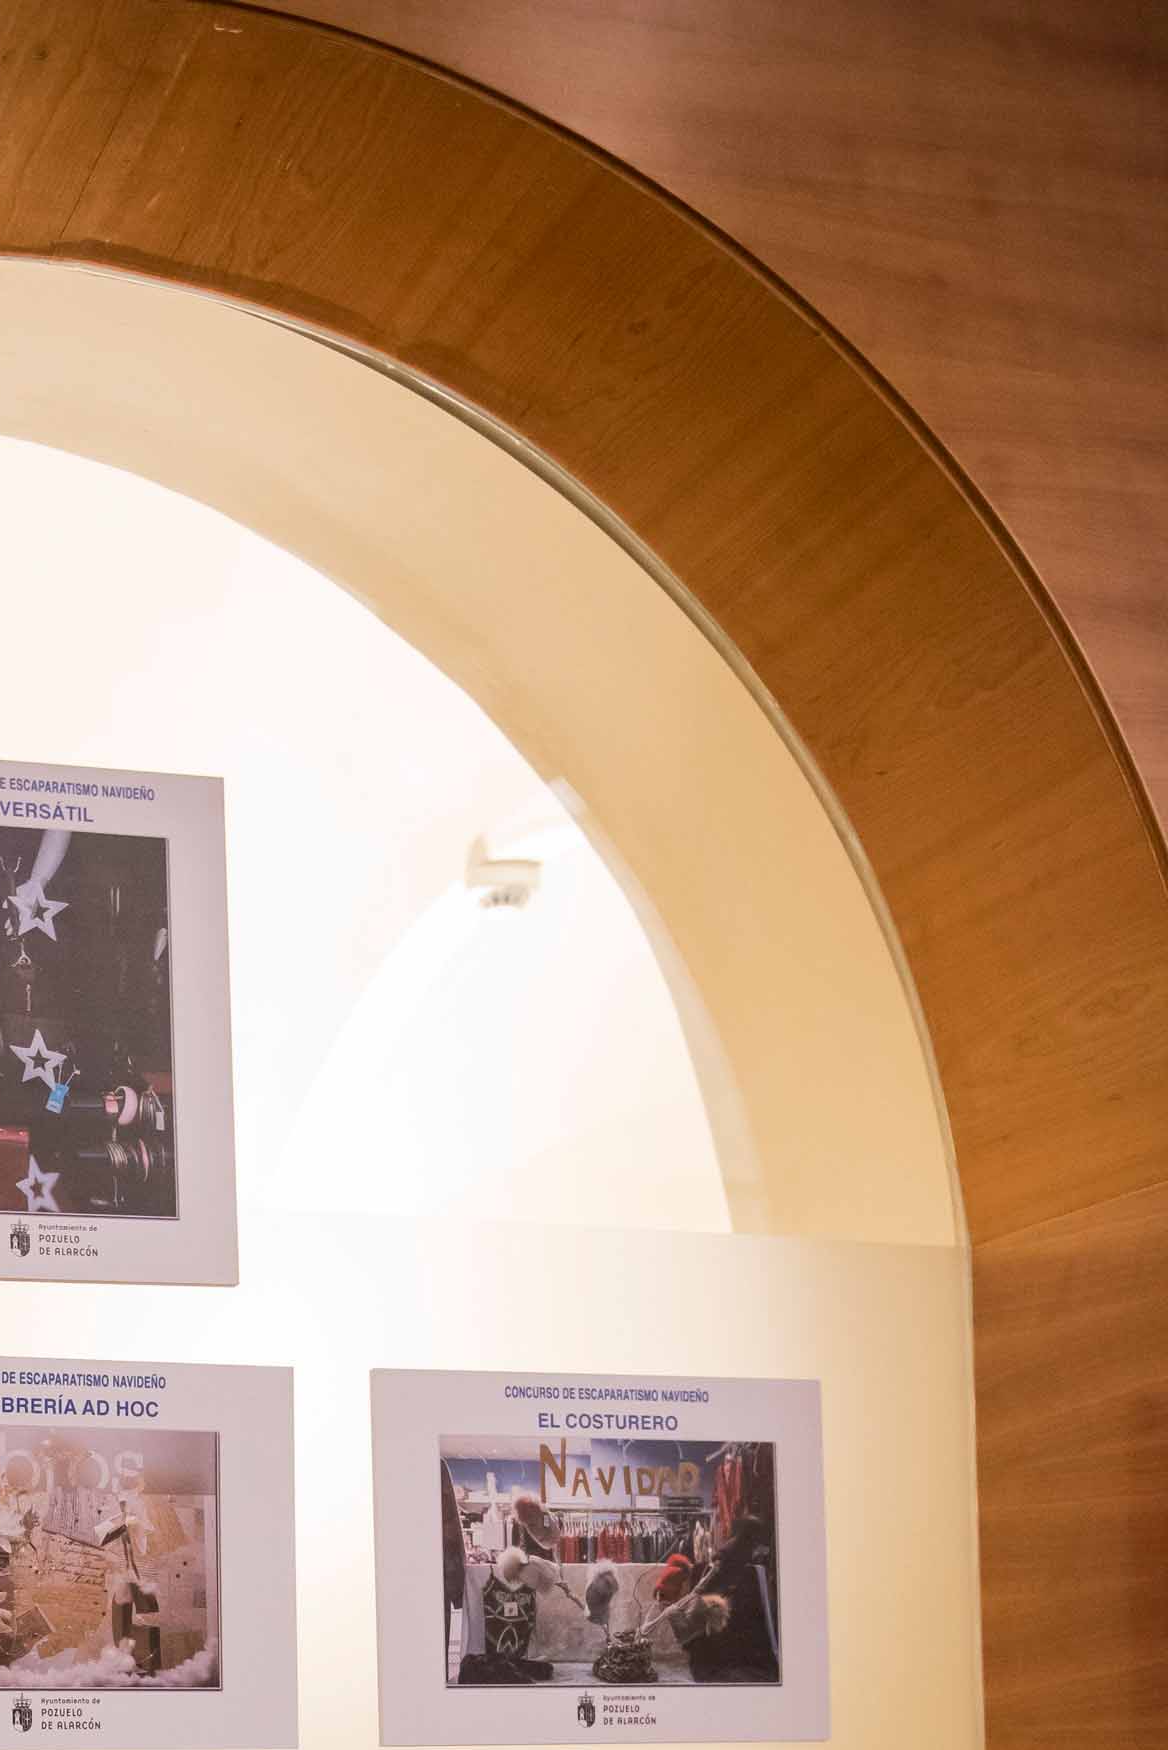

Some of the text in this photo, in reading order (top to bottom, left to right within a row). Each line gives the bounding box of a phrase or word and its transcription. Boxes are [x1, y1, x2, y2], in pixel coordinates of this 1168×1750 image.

[8, 777, 98, 796] ESCAPARATISMO
[101, 785, 154, 800] NAVIDEÑO
[0, 800, 93, 822] VERSÁTIL
[38, 1223, 87, 1232] Ayuntamiento
[38, 1233, 80, 1244] POZUELO
[39, 1244, 98, 1256] DE ALARCÓN
[1, 1371, 16, 1384] DE
[19, 1371, 109, 1387] ESCAPARATISMO
[112, 1373, 166, 1389] NAVIDEÑO
[504, 1385, 709, 1403] CONCURSO DE ESCAPARATISMO NAVIDEÑO
[81, 1399, 109, 1415] AD
[116, 1400, 158, 1417] HOC
[538, 1412, 677, 1431] EL COSTURERO
[40, 1697, 89, 1706] Ayuntamiento
[41, 1707, 82, 1717] POZUELO
[41, 1717, 100, 1730] DE ALARCÓN
